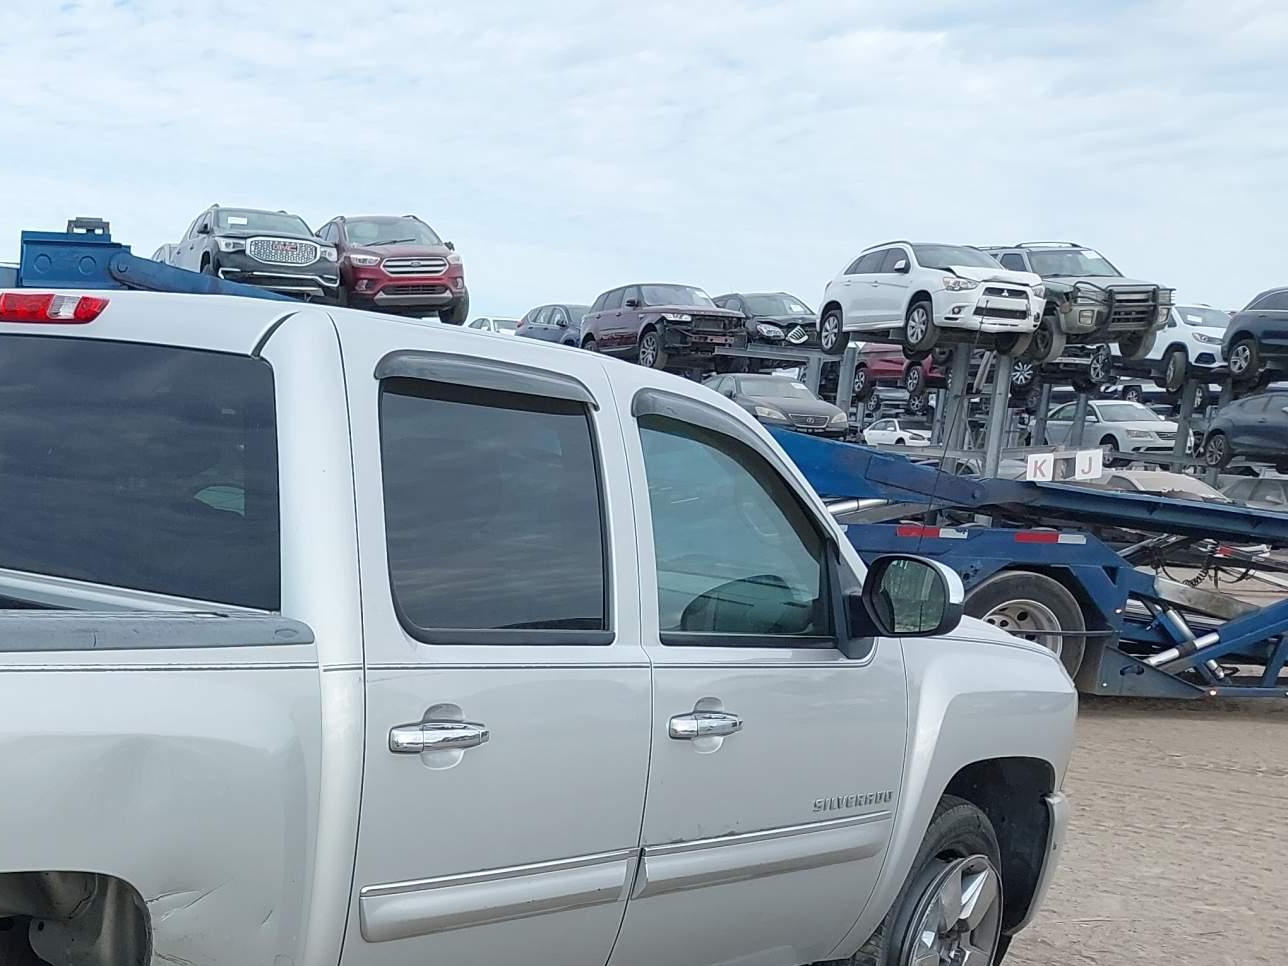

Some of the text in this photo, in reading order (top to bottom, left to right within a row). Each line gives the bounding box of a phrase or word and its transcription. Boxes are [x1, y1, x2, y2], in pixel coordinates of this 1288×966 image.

[1033, 459, 1047, 479] K
[1081, 456, 1093, 475] J
[812, 790, 893, 812] SILVERADO
